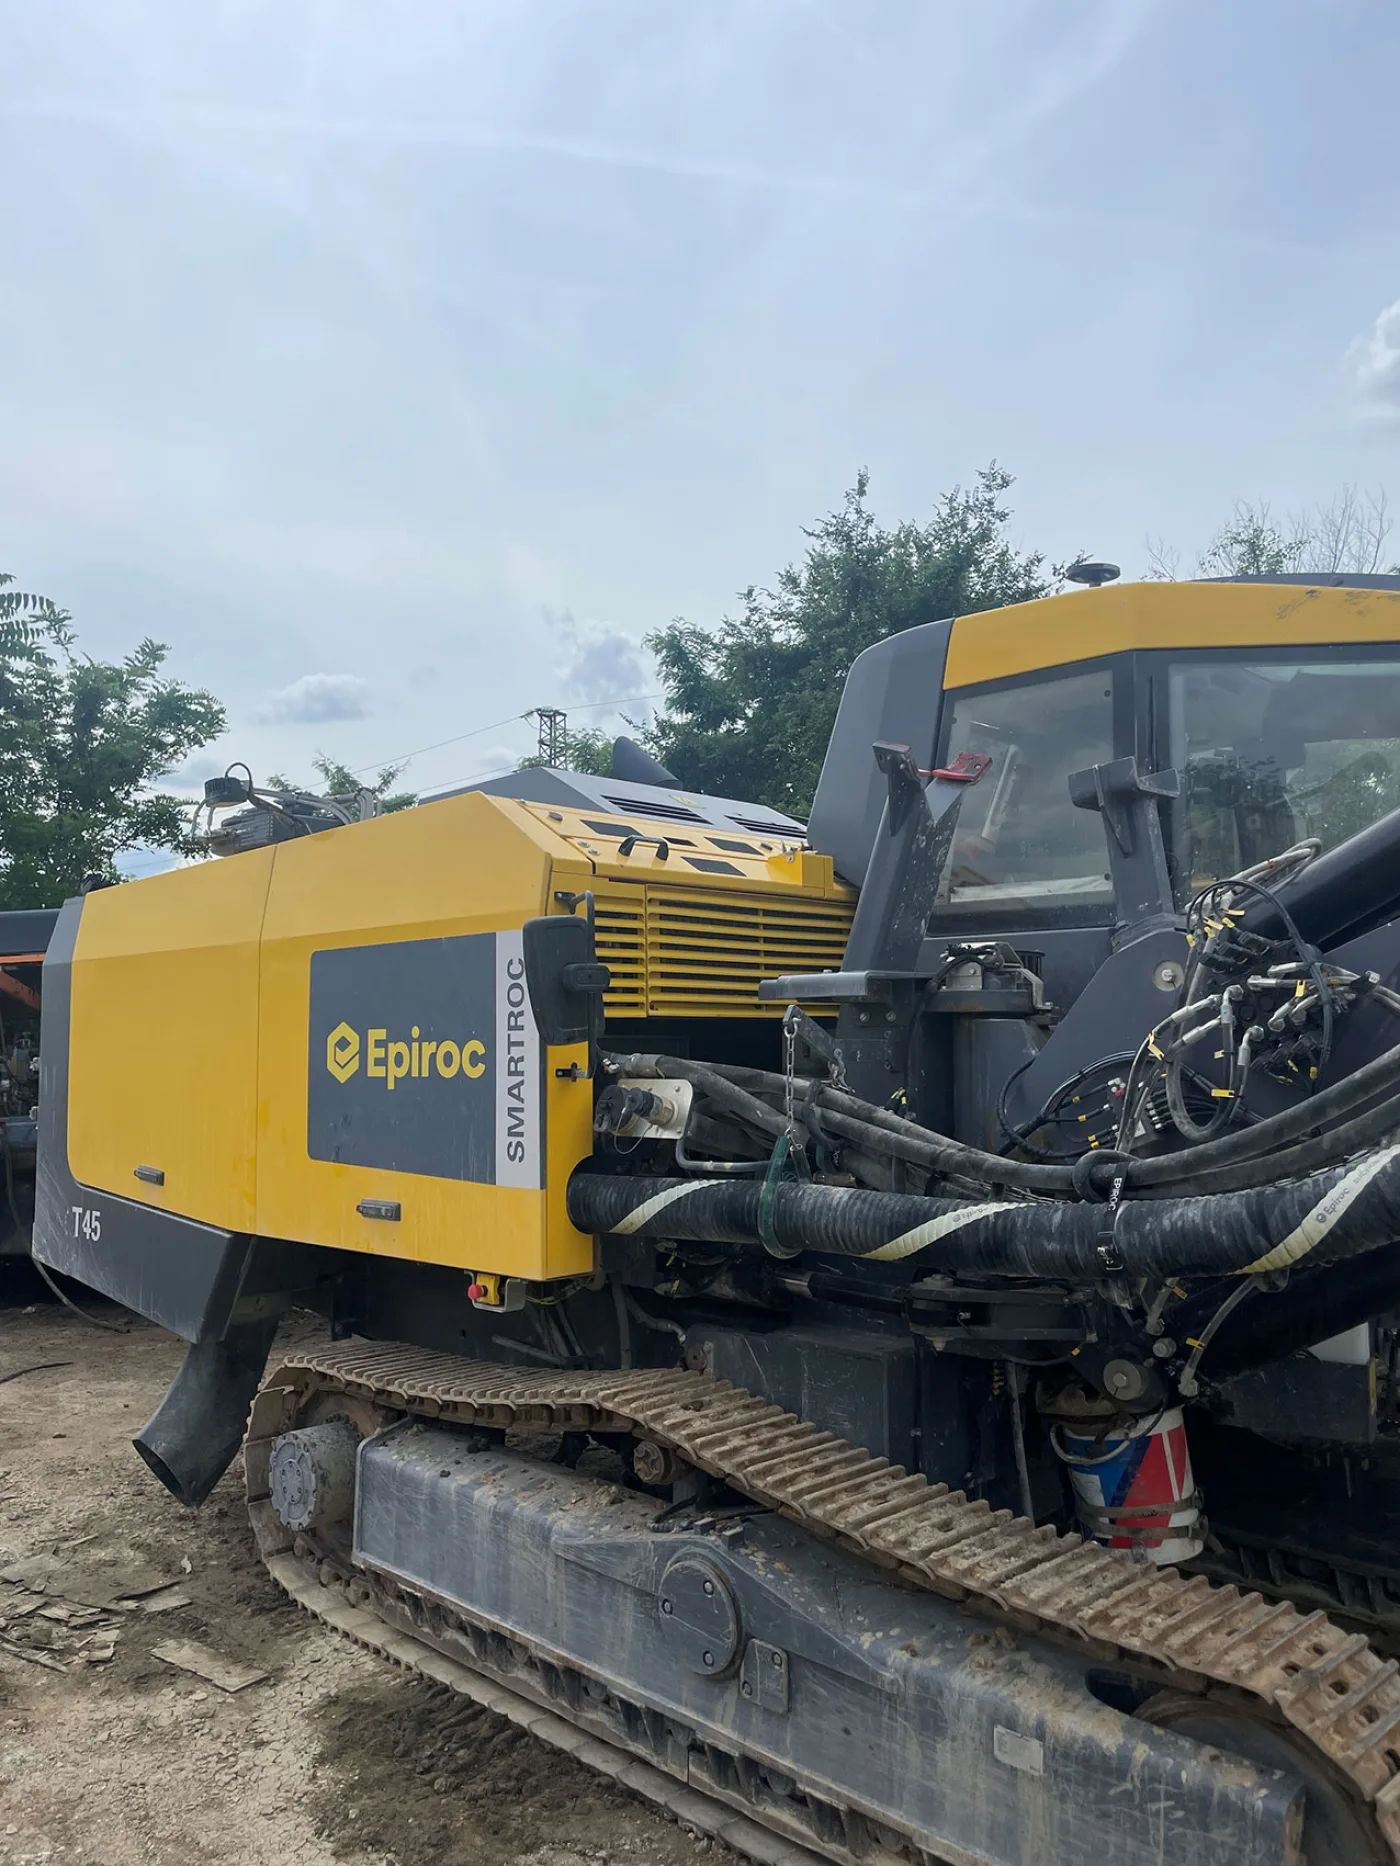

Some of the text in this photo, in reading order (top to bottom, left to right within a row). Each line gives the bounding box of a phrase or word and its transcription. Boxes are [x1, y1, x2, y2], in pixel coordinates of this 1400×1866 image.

[366, 1025, 487, 1091] Epiroc
[506, 957, 526, 1164] SMARTROC
[1107, 1177, 1123, 1211] EPIROC
[1323, 1187, 1350, 1216] Epiroc
[71, 1206, 101, 1242] T45
